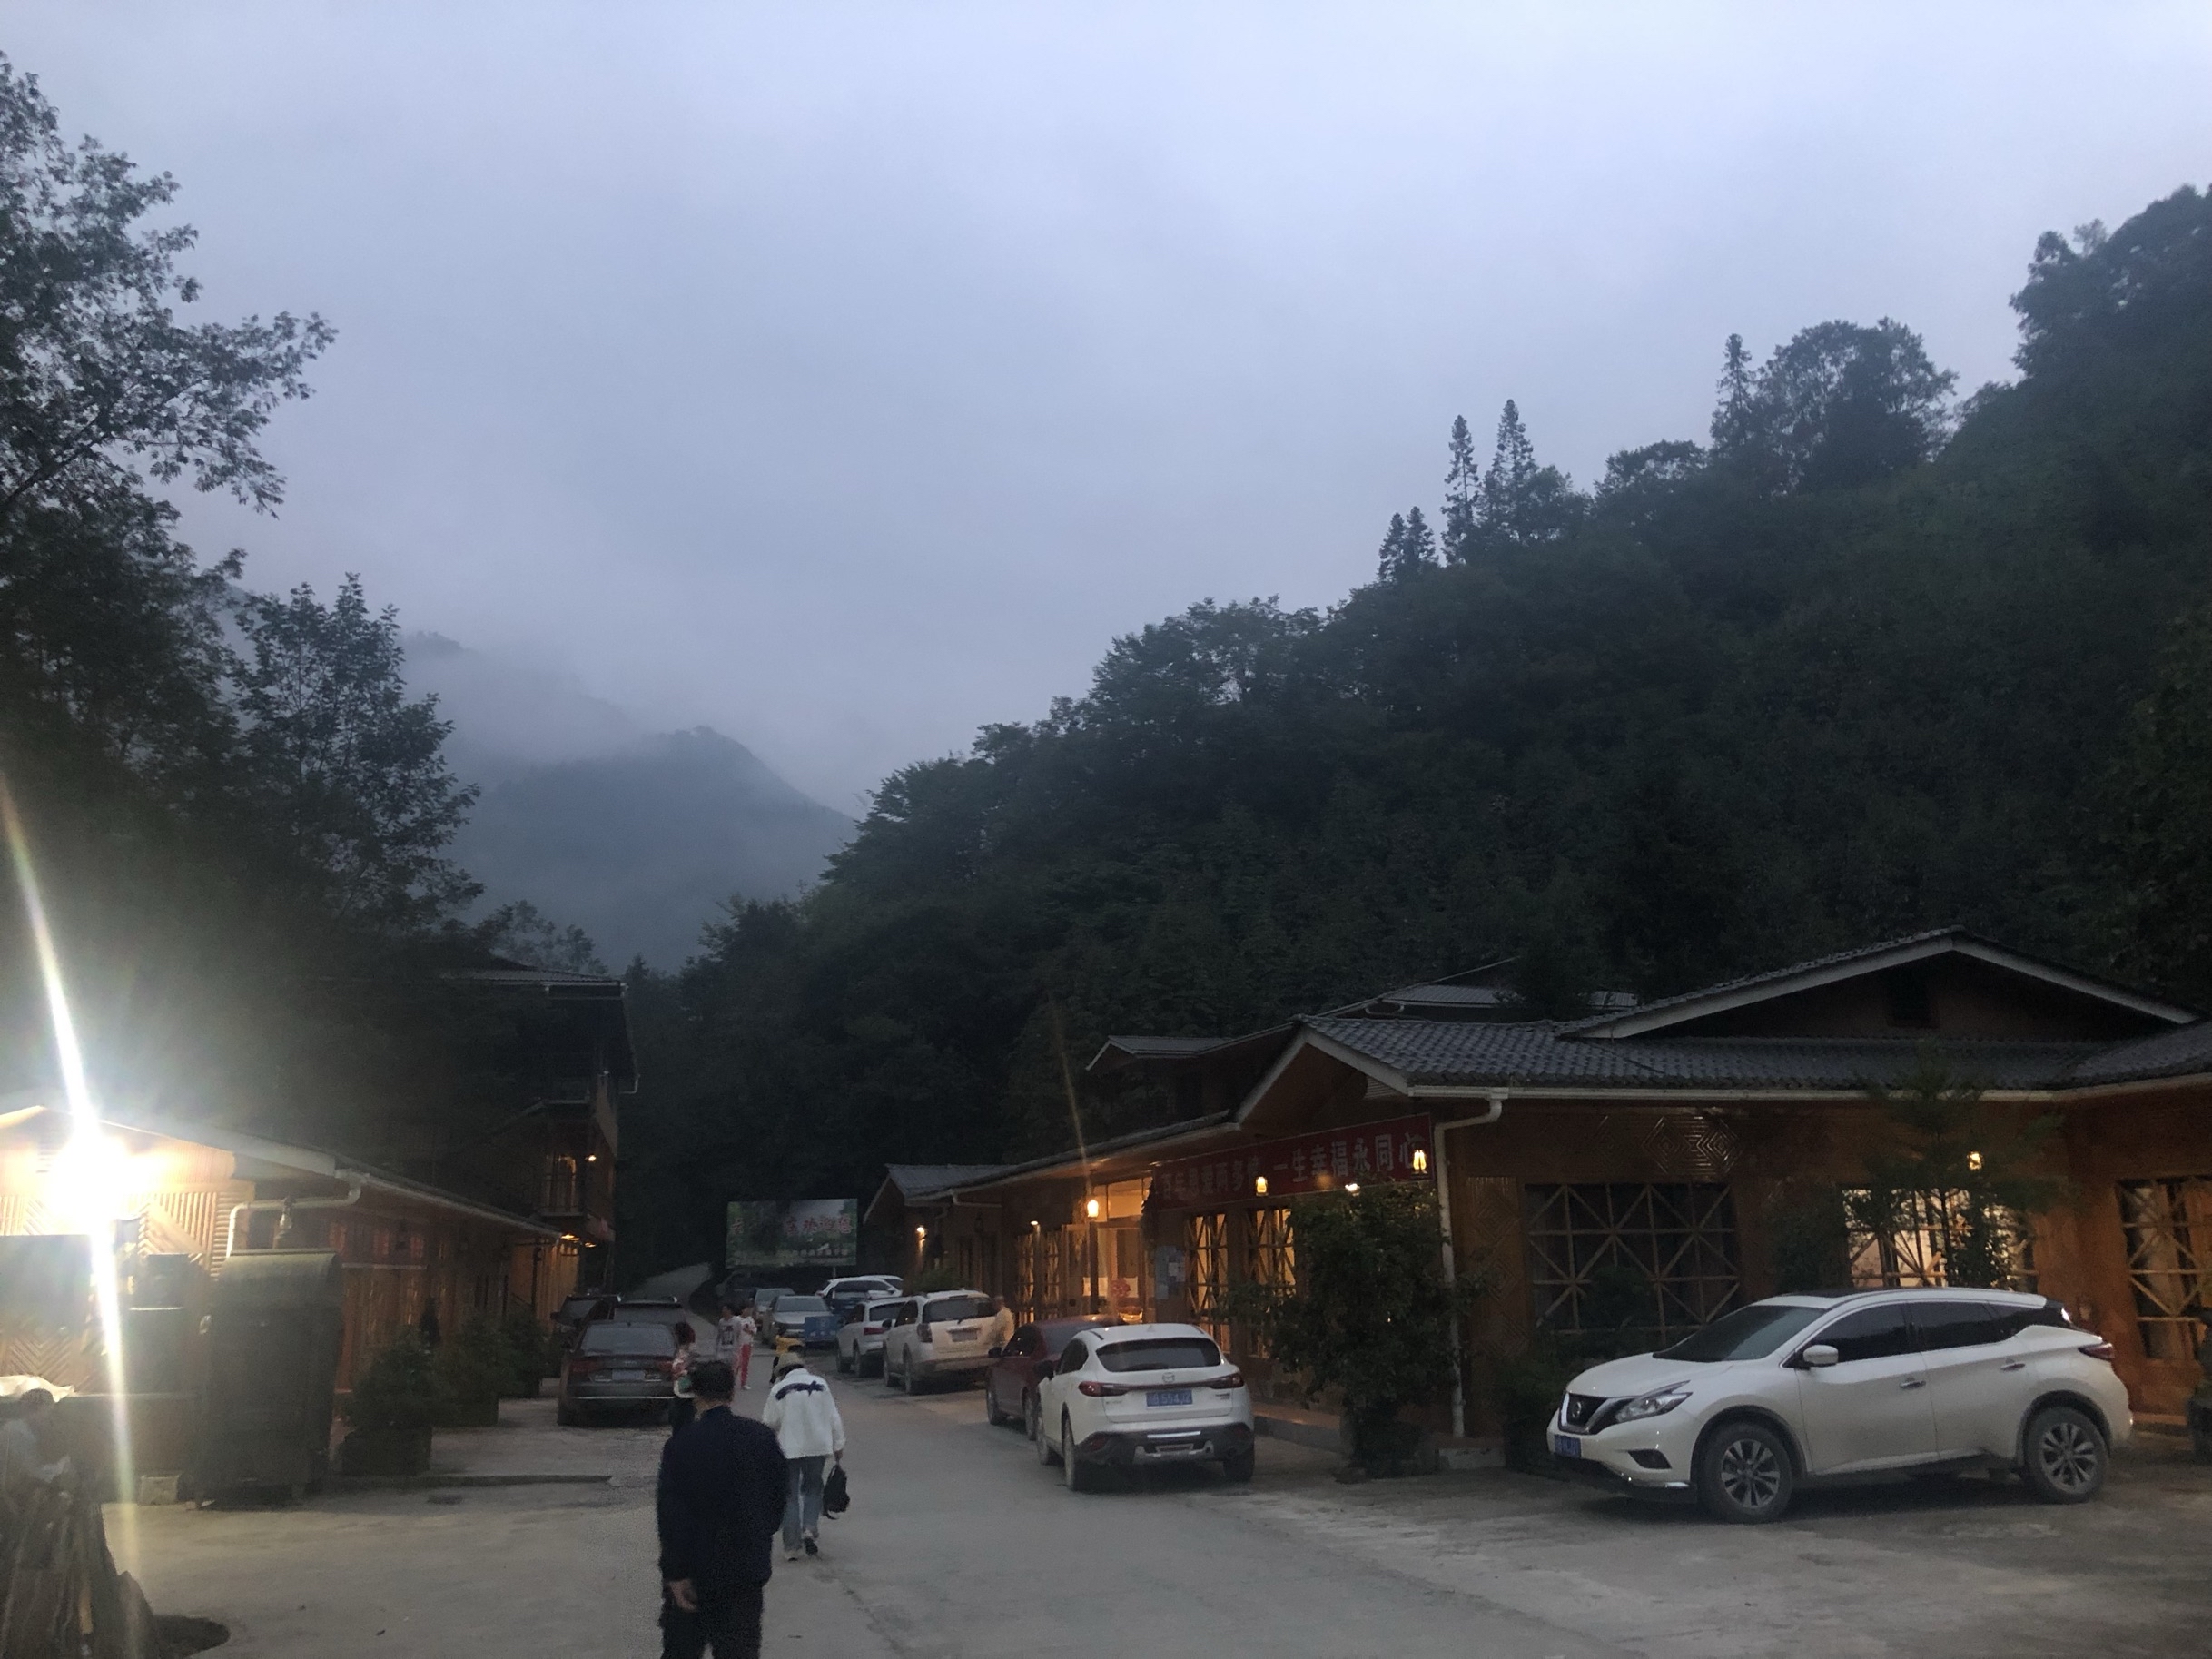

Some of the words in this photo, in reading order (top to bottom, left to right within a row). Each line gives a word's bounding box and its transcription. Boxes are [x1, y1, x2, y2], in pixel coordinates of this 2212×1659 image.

[1272, 1131, 1427, 1183] 一生幸福永同心
